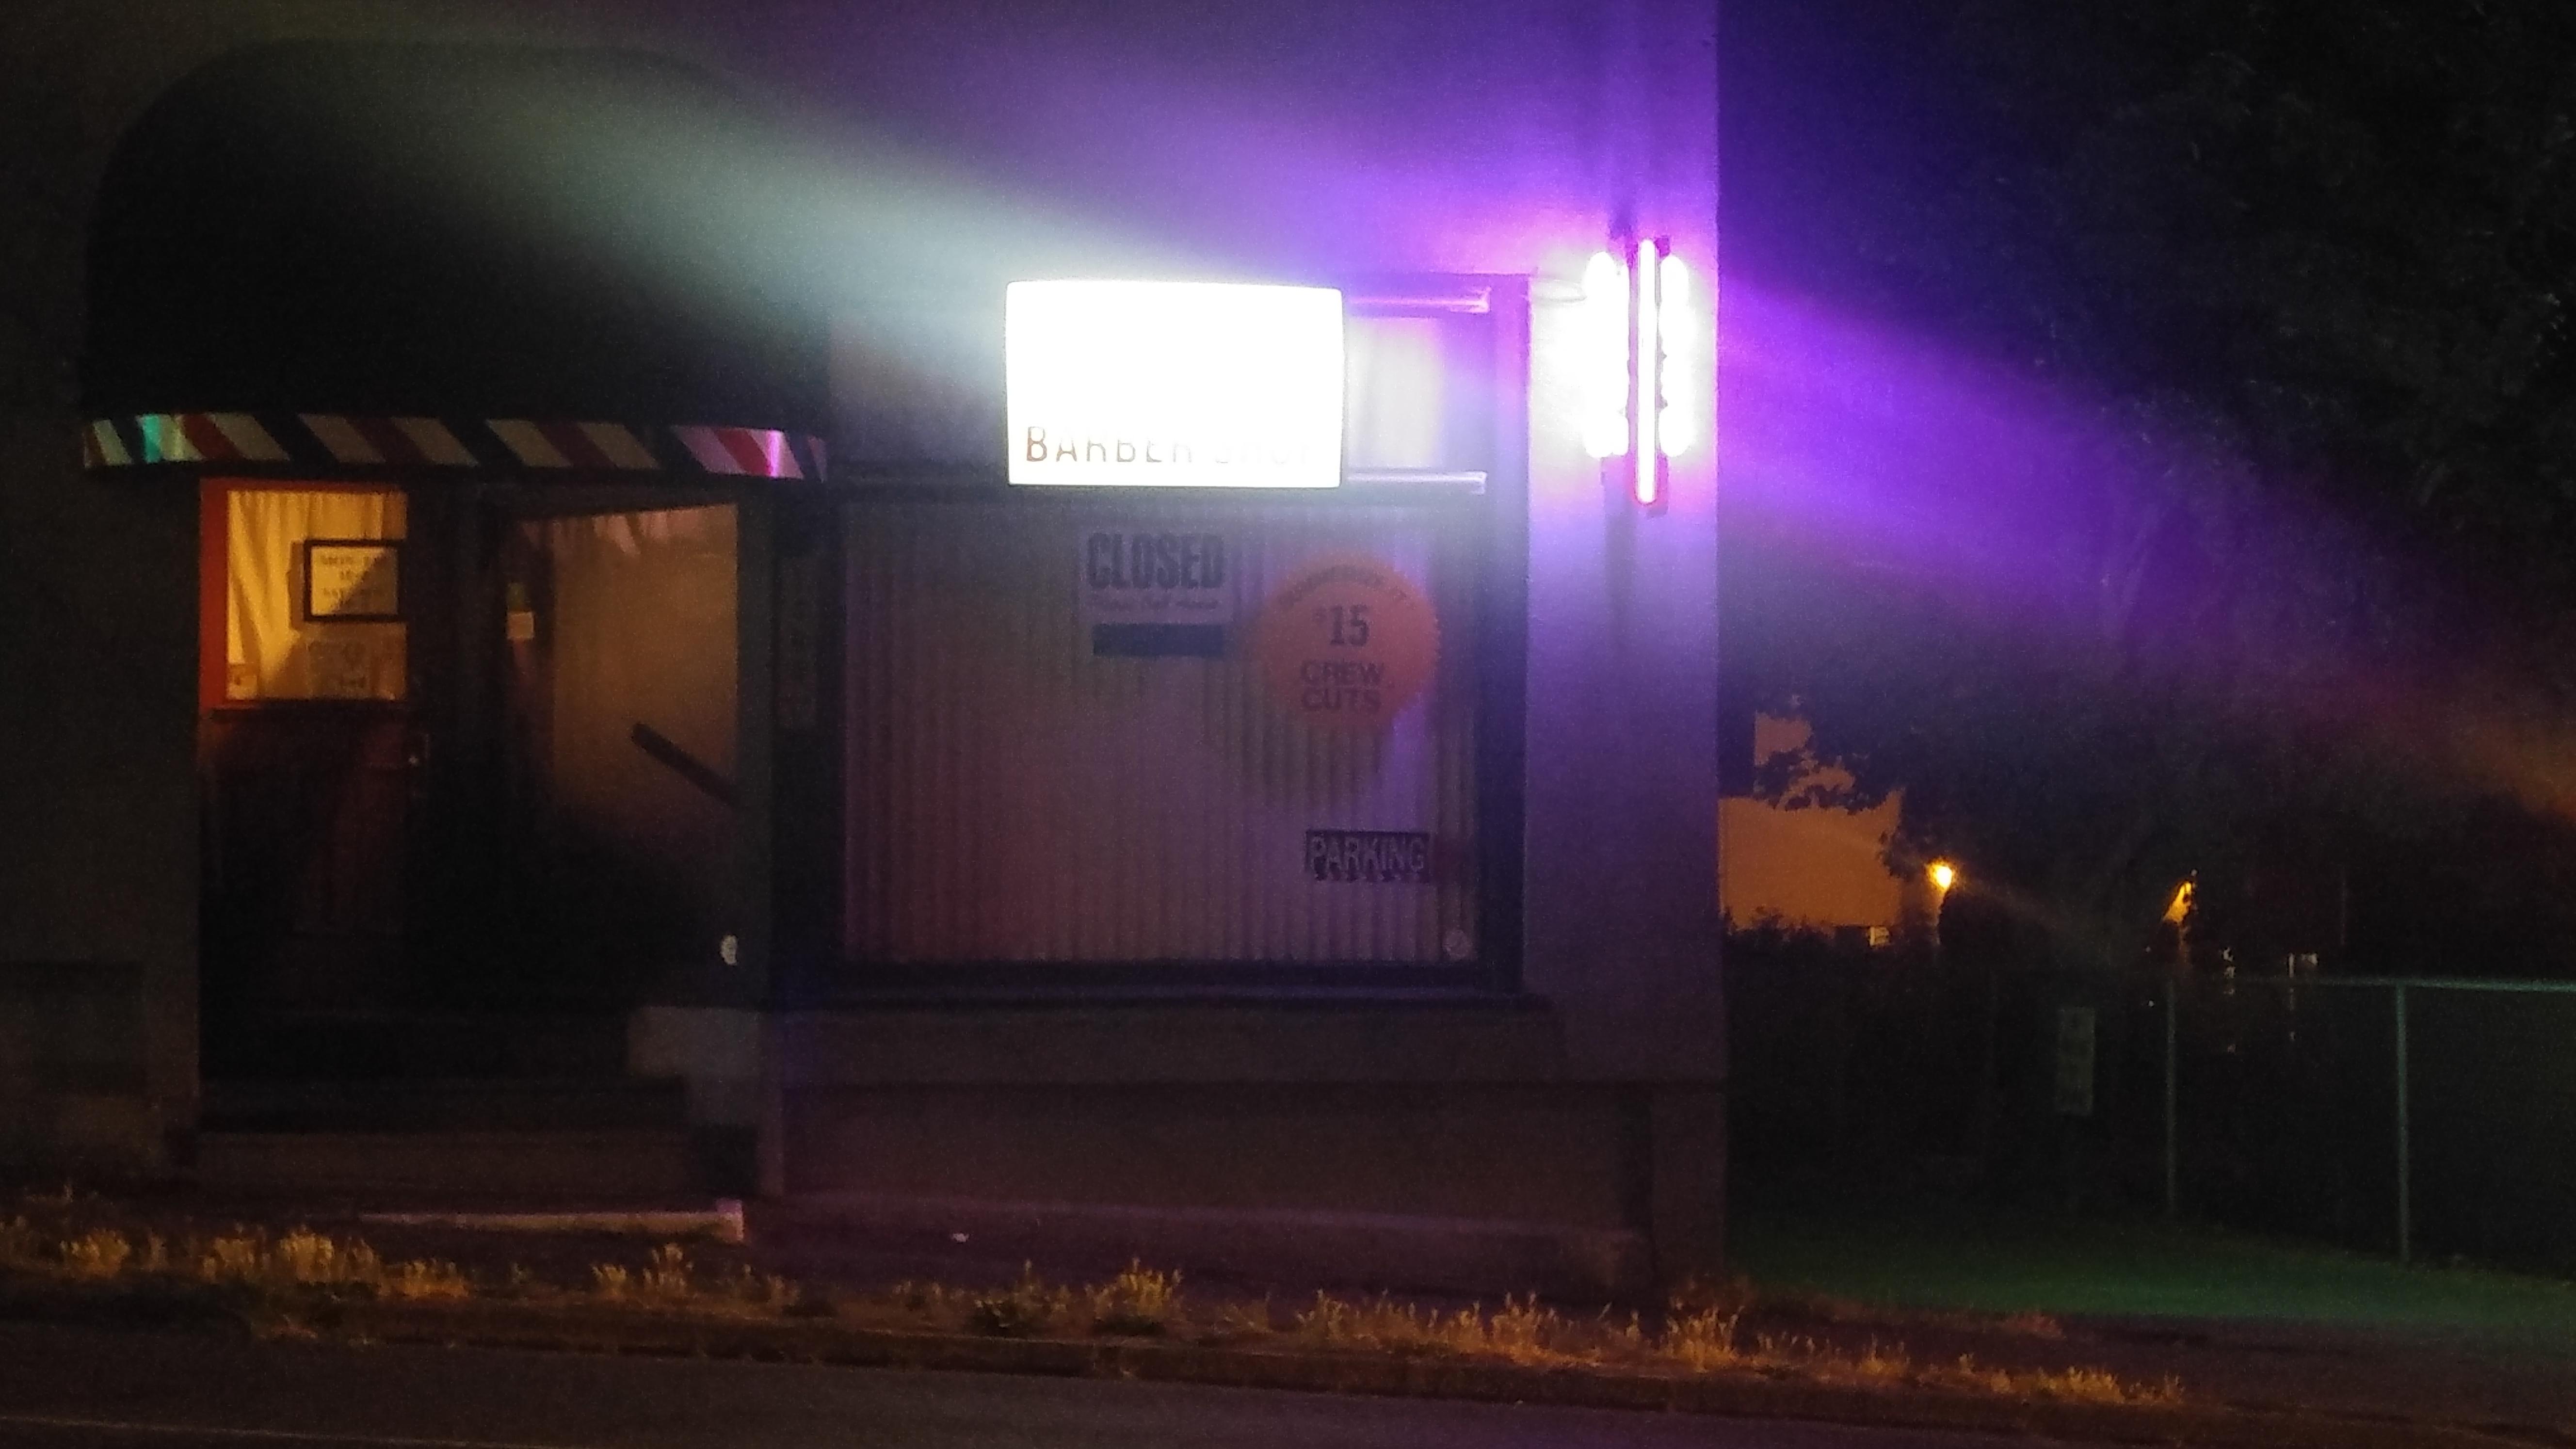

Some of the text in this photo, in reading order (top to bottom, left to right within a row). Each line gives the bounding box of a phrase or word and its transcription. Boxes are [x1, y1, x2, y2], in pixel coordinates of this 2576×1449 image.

[1088, 532, 1224, 589] CLOSED
[1300, 660, 1385, 684] CREW
[1301, 687, 1382, 714] CUTS
[1309, 836, 1424, 871] PARKING
